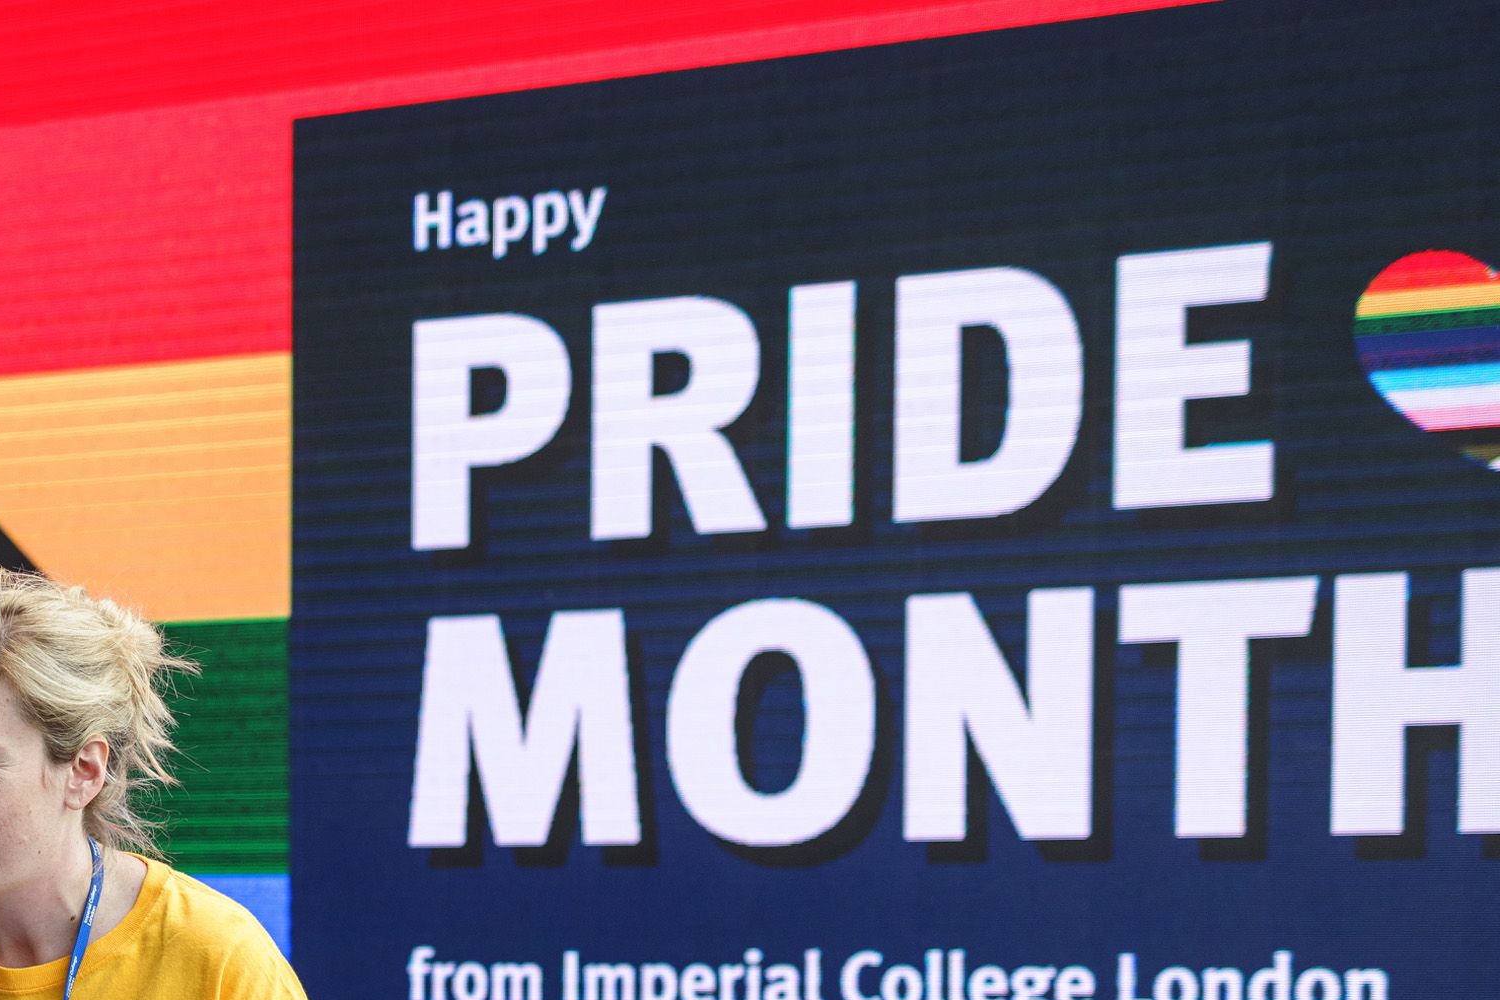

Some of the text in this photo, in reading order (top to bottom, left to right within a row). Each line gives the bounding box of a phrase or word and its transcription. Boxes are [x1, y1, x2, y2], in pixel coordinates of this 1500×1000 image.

[412, 187, 607, 258] Happy
[411, 241, 1274, 551] PRIDE
[408, 566, 1500, 849] MONTH
